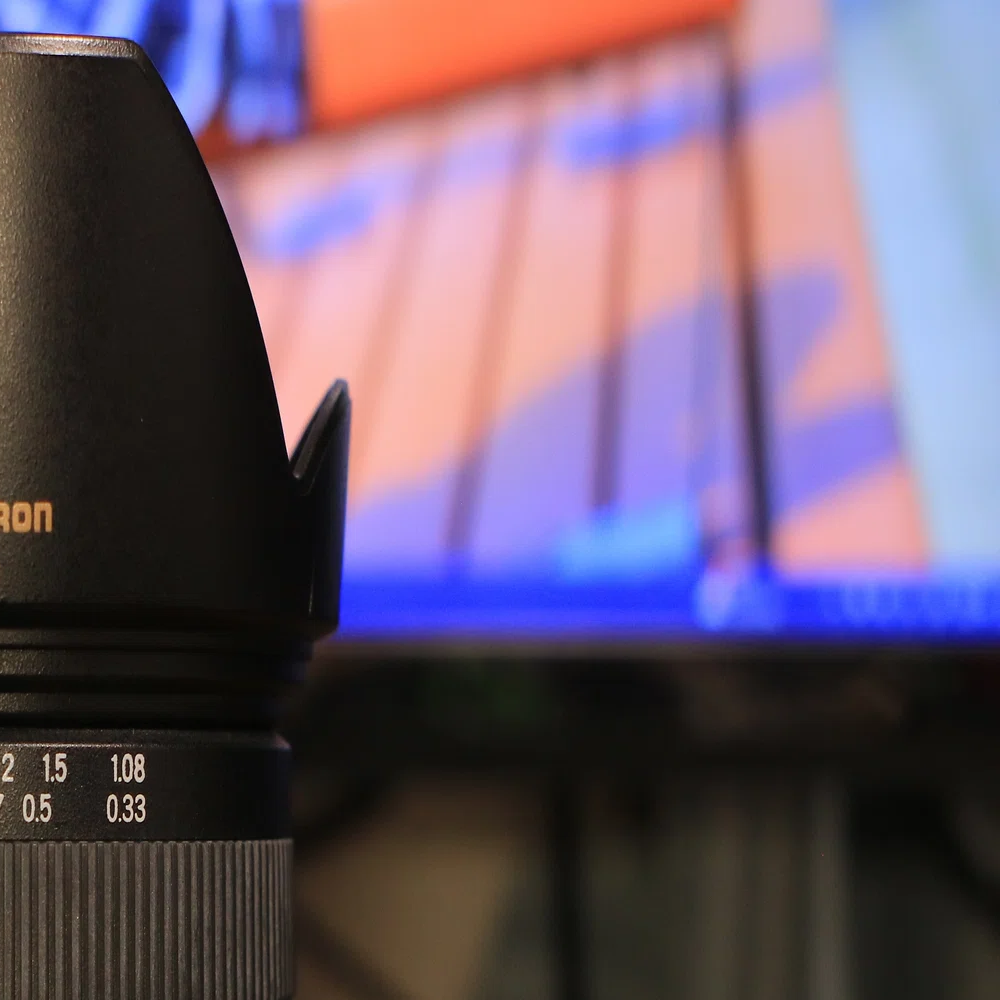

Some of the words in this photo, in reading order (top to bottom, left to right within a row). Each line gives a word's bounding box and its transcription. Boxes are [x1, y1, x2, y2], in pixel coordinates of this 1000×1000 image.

[1, 753, 15, 782] 2
[42, 753, 68, 782] 1.5
[111, 754, 146, 783] 1.08
[22, 794, 52, 823] 0.5
[106, 794, 147, 823] 0.33
